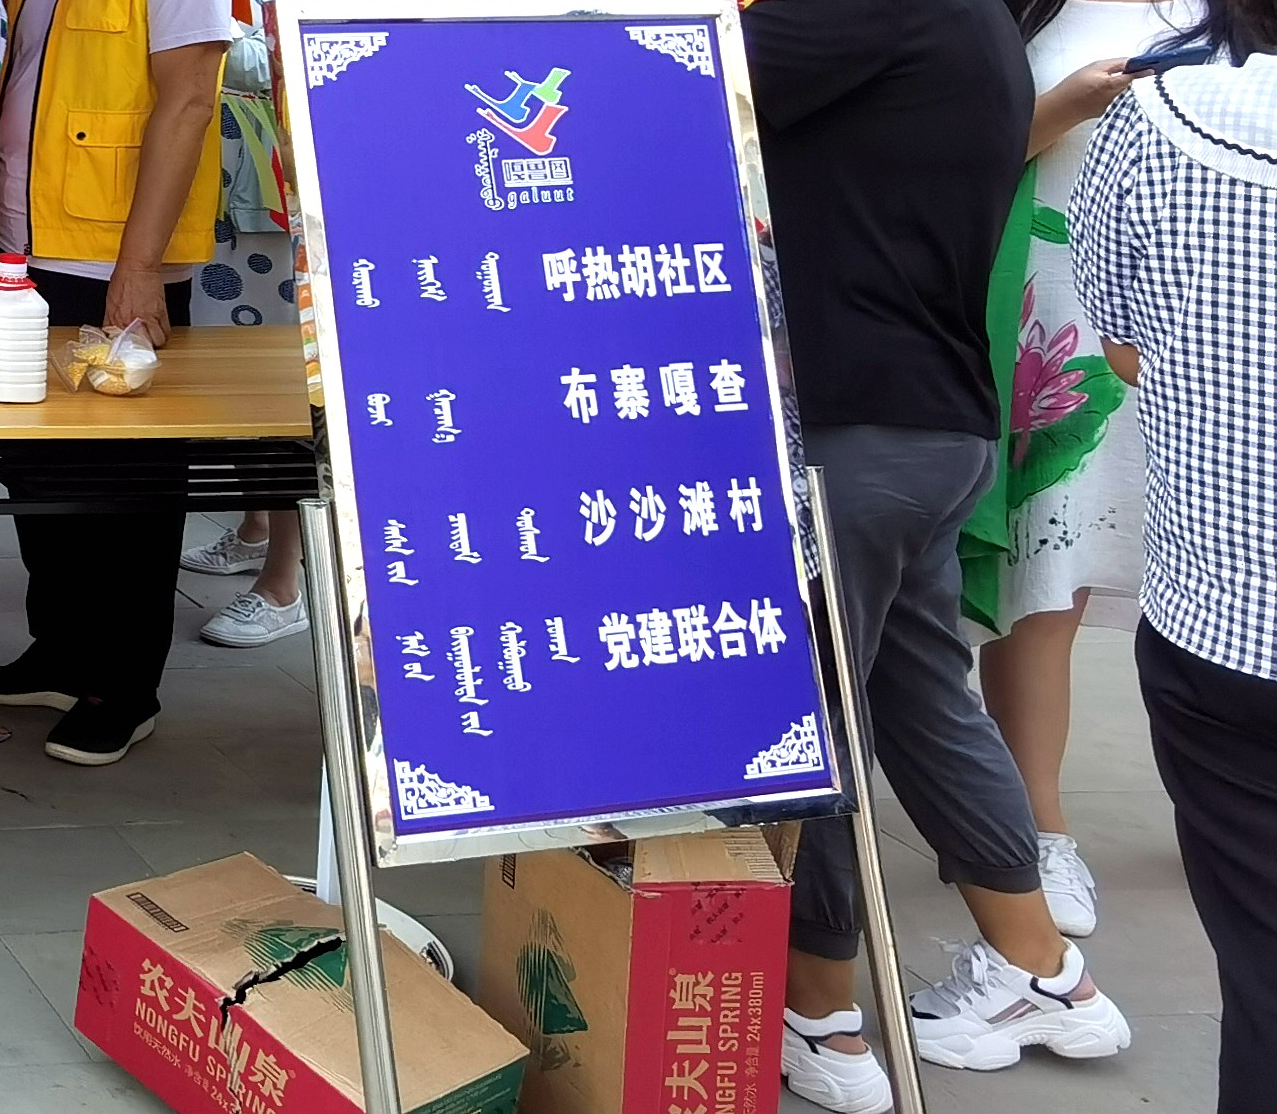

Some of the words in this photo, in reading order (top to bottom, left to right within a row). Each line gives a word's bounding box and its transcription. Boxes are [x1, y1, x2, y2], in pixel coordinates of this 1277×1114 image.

[507, 187, 575, 209] galuut
[542, 243, 732, 303] 呼热胡社区
[560, 358, 749, 424] 布寨嘎查
[579, 476, 764, 546] 沙沙滩村
[598, 597, 787, 671] 党建联合体
[135, 998, 201, 1063] NONGFU
[139, 958, 289, 1107] 农夫山泉
[664, 970, 715, 1114] 夫山泉
[717, 972, 744, 1052] SPRING
[747, 971, 765, 1043] 24x380ml
